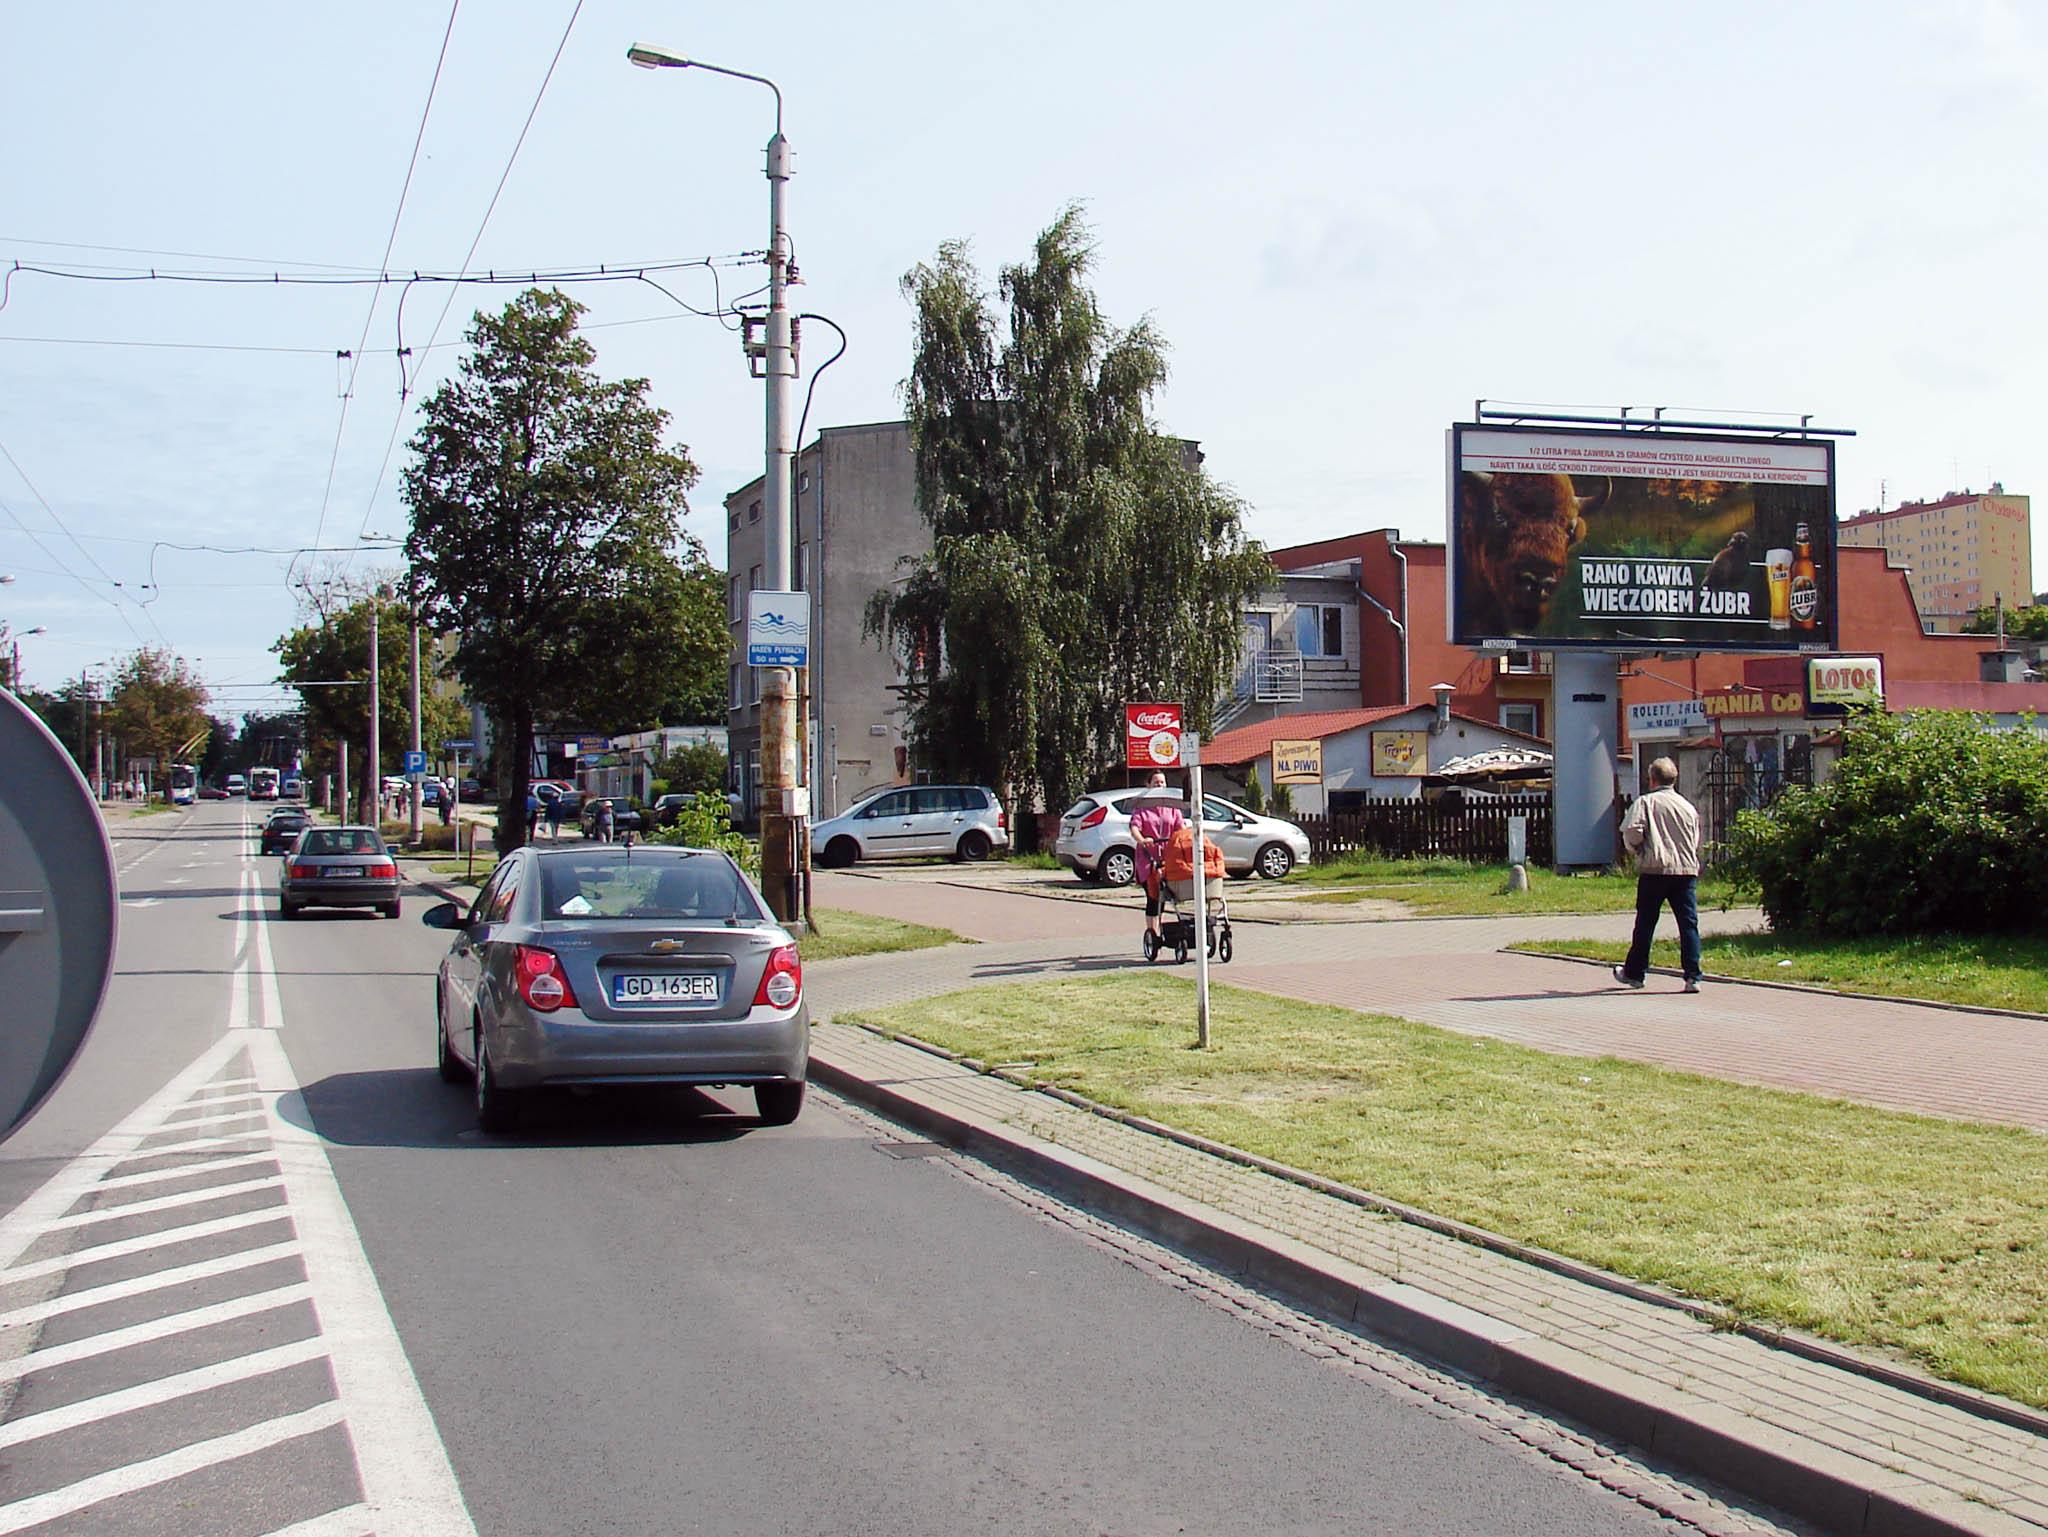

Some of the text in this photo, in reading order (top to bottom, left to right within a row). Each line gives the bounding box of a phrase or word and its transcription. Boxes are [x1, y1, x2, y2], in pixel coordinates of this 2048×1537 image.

[1529, 447, 1541, 455] 1/2
[1542, 448, 1562, 456] LITRA
[1564, 449, 1582, 457] PIWA
[1583, 449, 1614, 458] ZAWIERA
[1659, 453, 1694, 462] CZYSTEGO
[1695, 455, 1731, 464] ALKOHOLU
[1731, 456, 1772, 465] ETYLOWEGO
[1490, 461, 1515, 470] NAWET
[1517, 462, 1535, 471] TAKA
[1558, 464, 1588, 472] SZKODZI
[1589, 465, 1621, 473] ZDROWIU
[1623, 466, 1646, 475] KOBIET
[1649, 467, 1655, 475] W
[1682, 469, 1698, 477] JEST
[1700, 470, 1751, 480] NIEBEZPIECZNA
[1753, 472, 1766, 480] DLA
[1767, 473, 1808, 482] KIEROWCÓW
[1582, 563, 1694, 586] RANO KAWKA
[1582, 586, 1750, 616] WIECZOREM ŻUBR
[755, 655, 767, 663] 50
[1815, 668, 1876, 690] LOTOS
[1632, 704, 1674, 718] ROLETY,
[1704, 692, 1802, 715] TANIA OD
[1136, 711, 1174, 726] Coca-Cola
[410, 753, 422, 770] P
[1277, 760, 1318, 771] NA PIWO
[627, 976, 714, 995] GD 163ER
